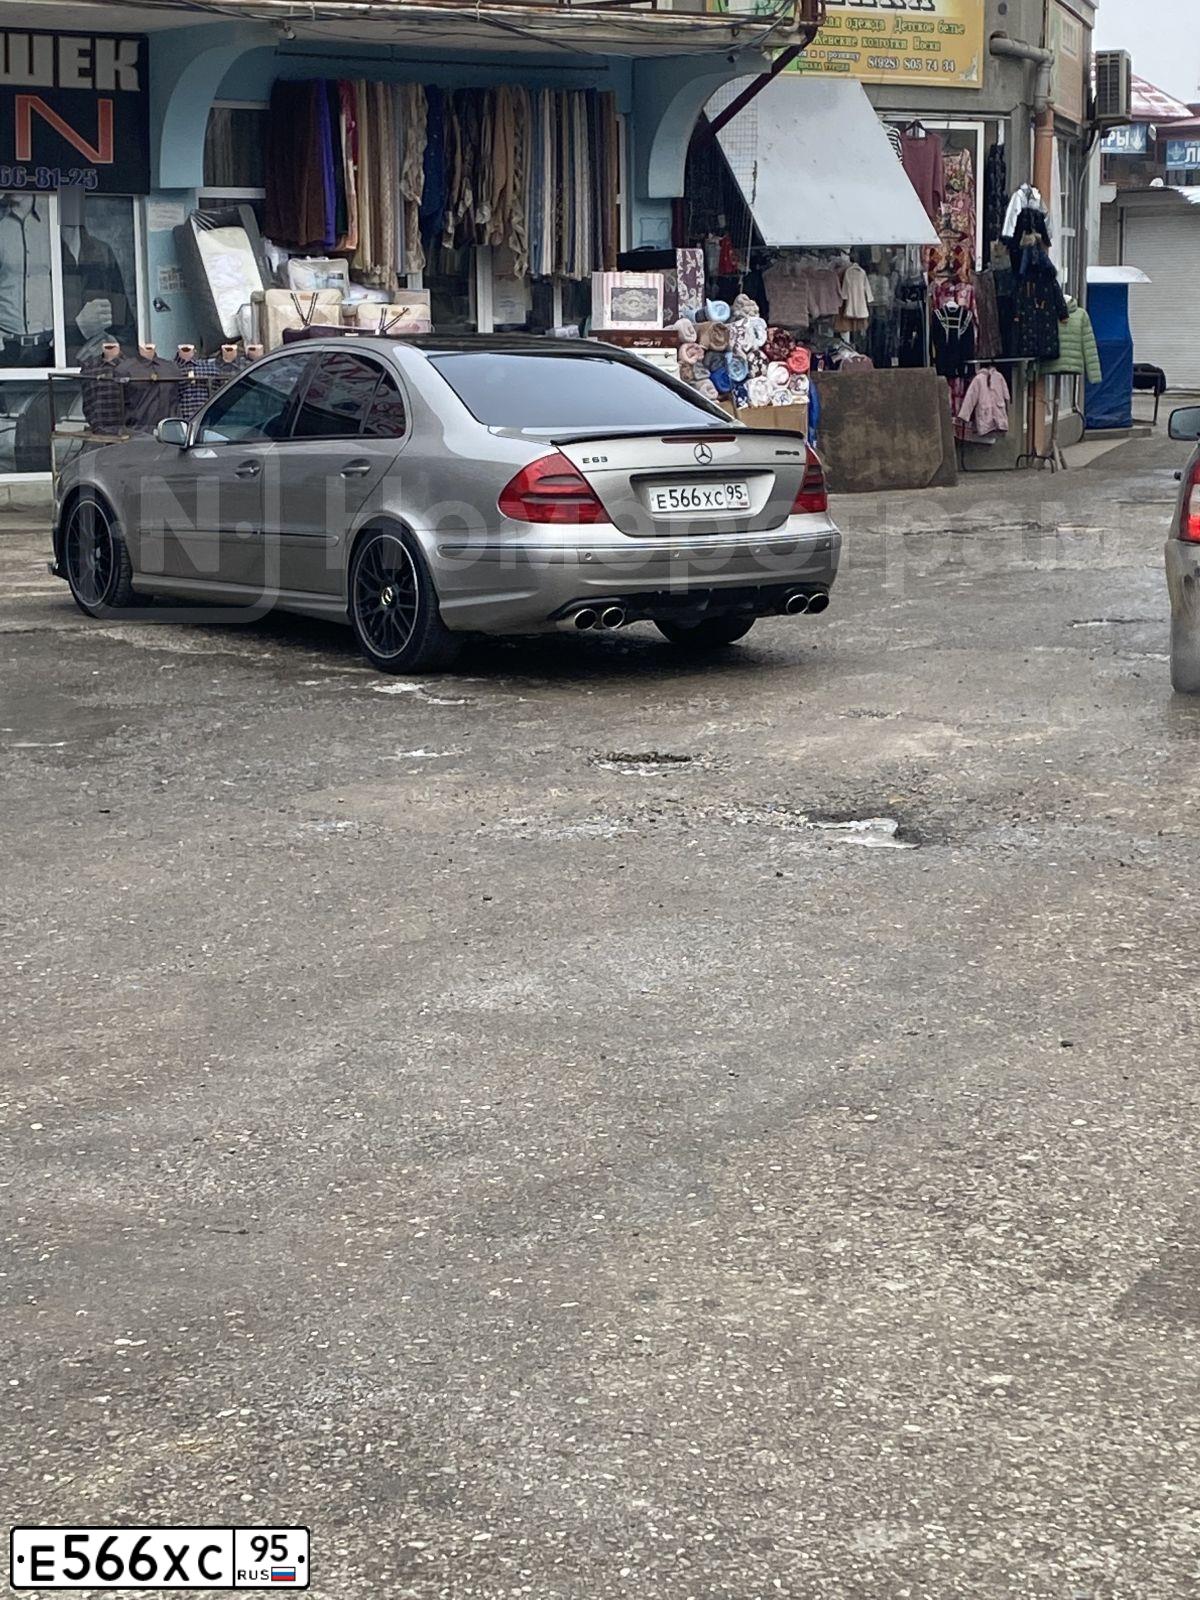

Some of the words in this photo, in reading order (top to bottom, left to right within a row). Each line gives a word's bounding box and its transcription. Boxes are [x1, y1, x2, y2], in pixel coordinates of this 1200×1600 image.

[845, 17, 885, 32] одежда
[894, 16, 934, 34] Детское
[938, 19, 965, 35] белье
[861, 37, 907, 50] колготки
[913, 36, 941, 51] Носки
[867, 56, 900, 70] 8(928)
[903, 57, 922, 71] 805
[926, 58, 939, 72] 74
[942, 59, 956, 73] 34
[726, 485, 743, 500] 95
